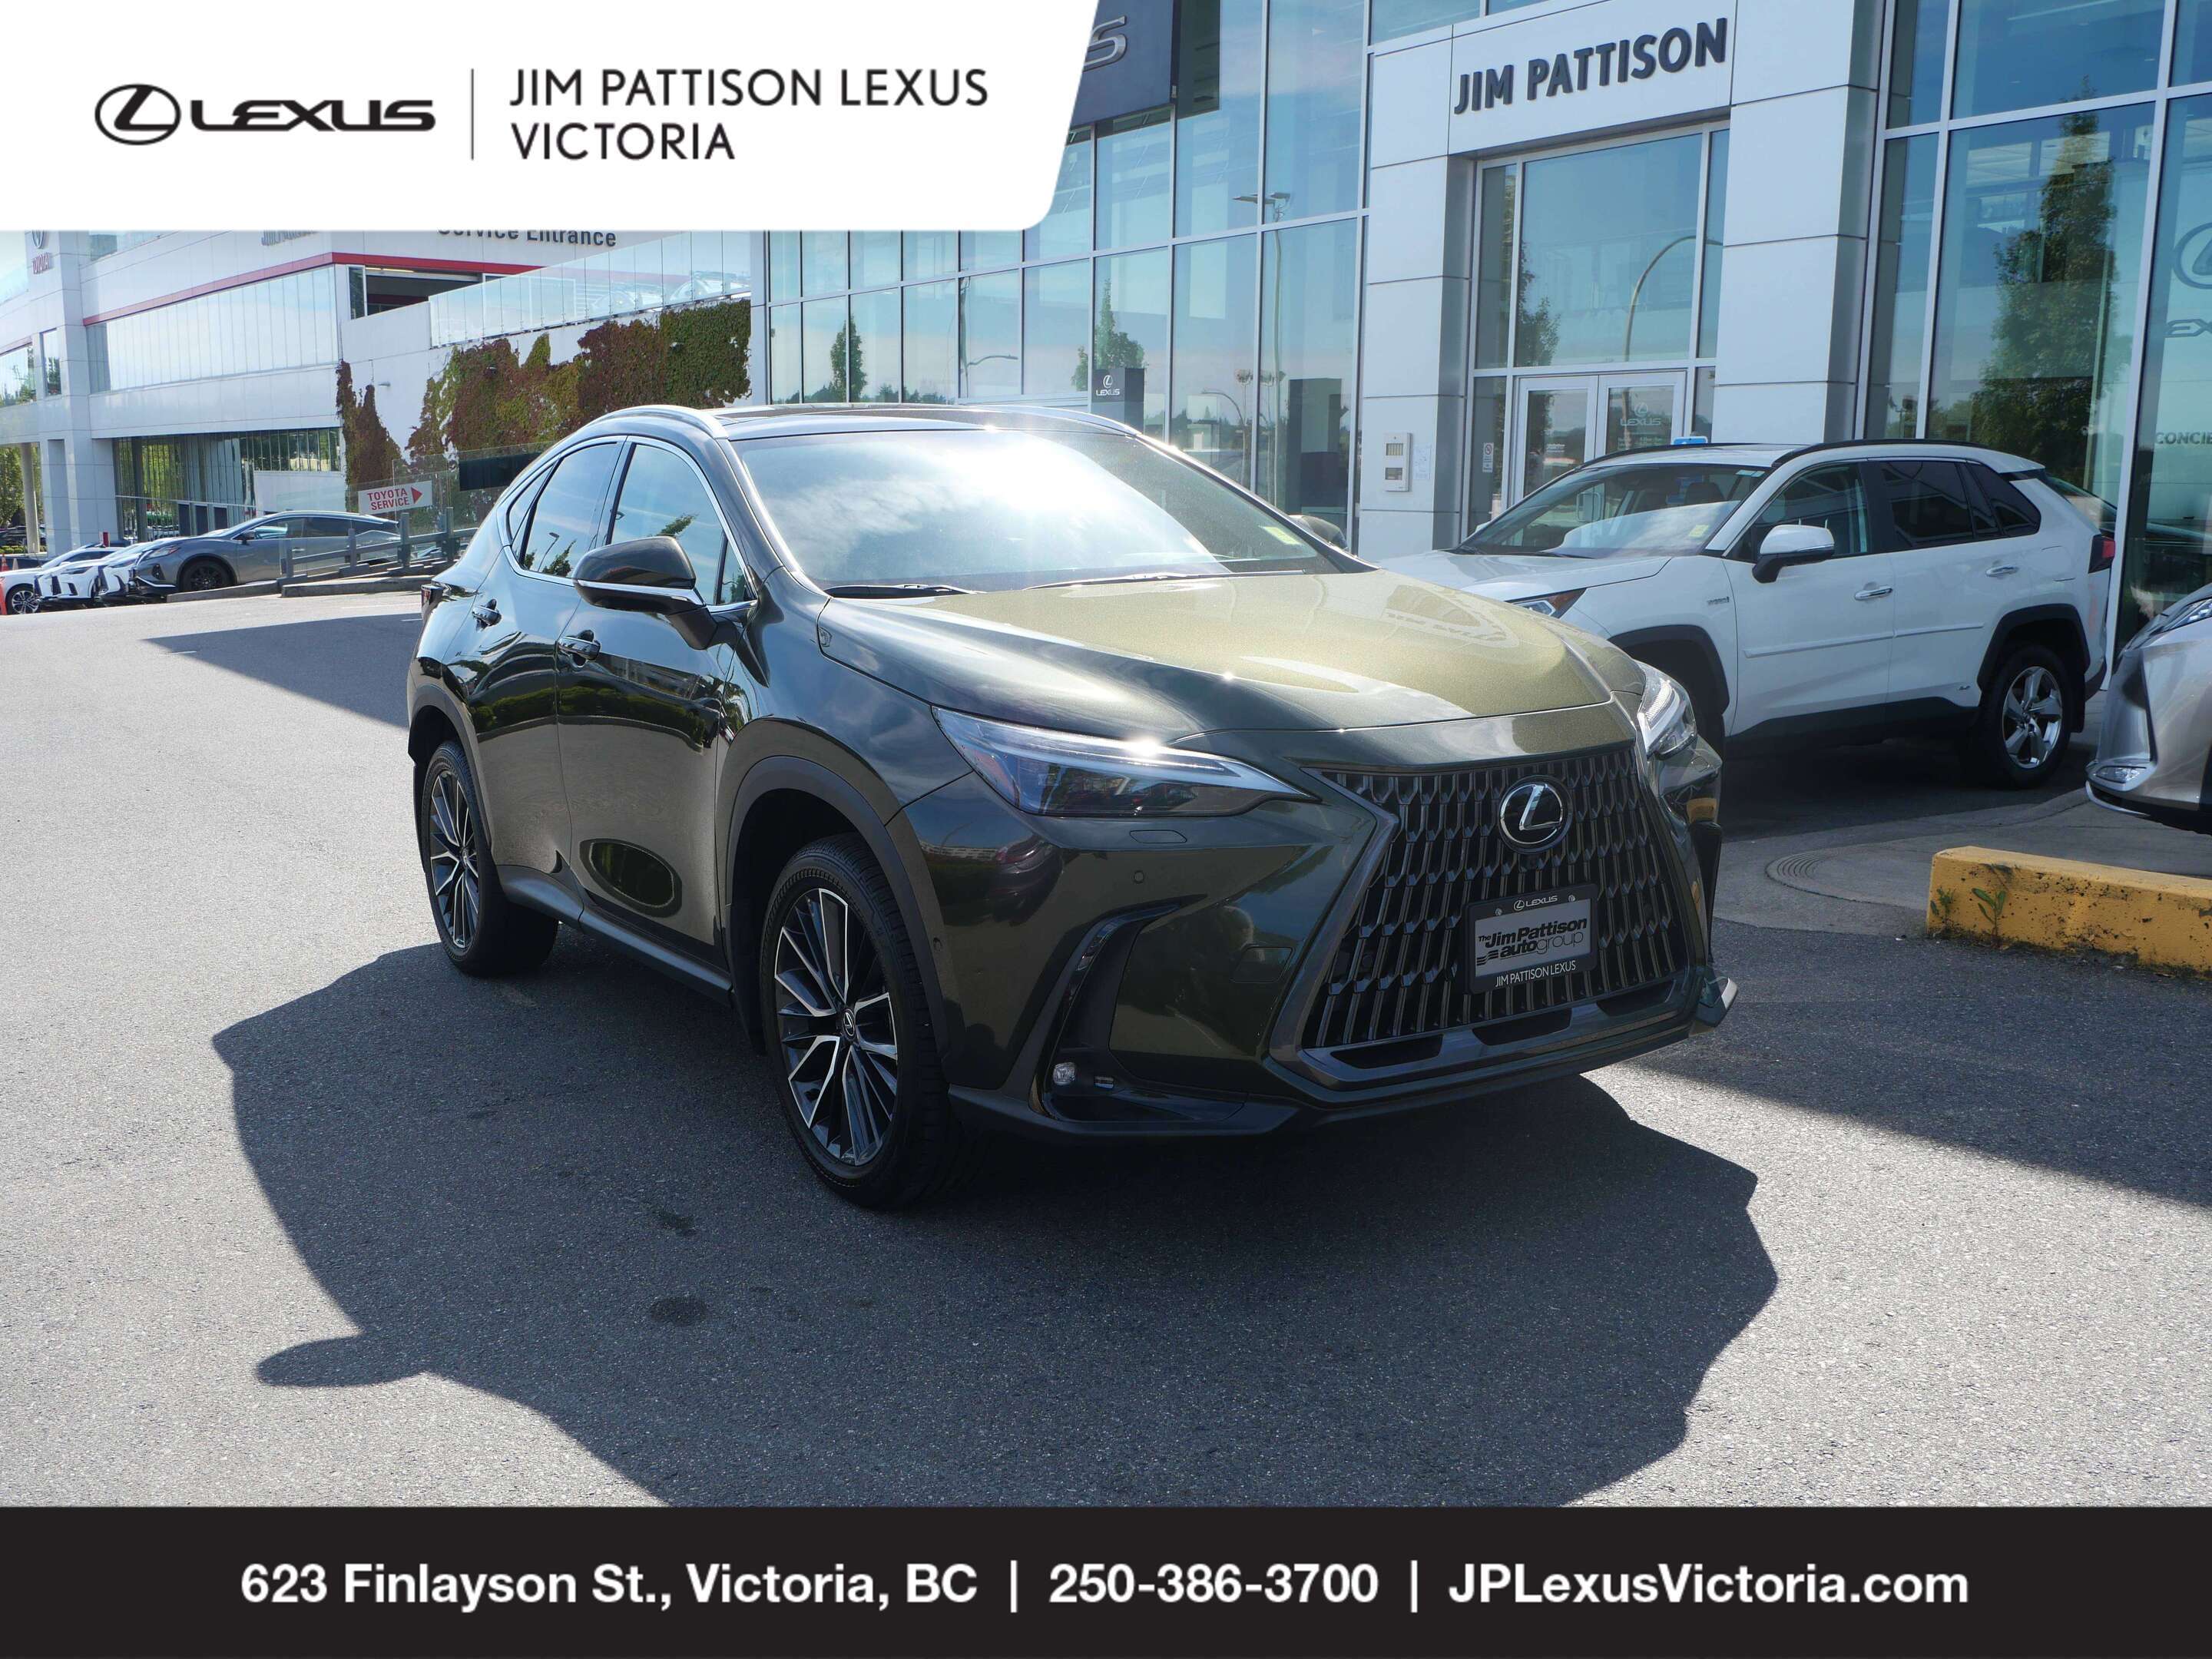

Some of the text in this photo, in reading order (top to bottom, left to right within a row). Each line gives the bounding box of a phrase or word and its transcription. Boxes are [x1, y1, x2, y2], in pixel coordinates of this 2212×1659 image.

[1454, 17, 1727, 114] JIM PATTISON
[1620, 418, 1661, 426] LEXUS
[367, 488, 408, 502] TOYOTA
[370, 497, 410, 511] SERVICE
[1525, 895, 1558, 907] LEXUS
[1495, 959, 1576, 988] JIM PATTISON LEXUS
